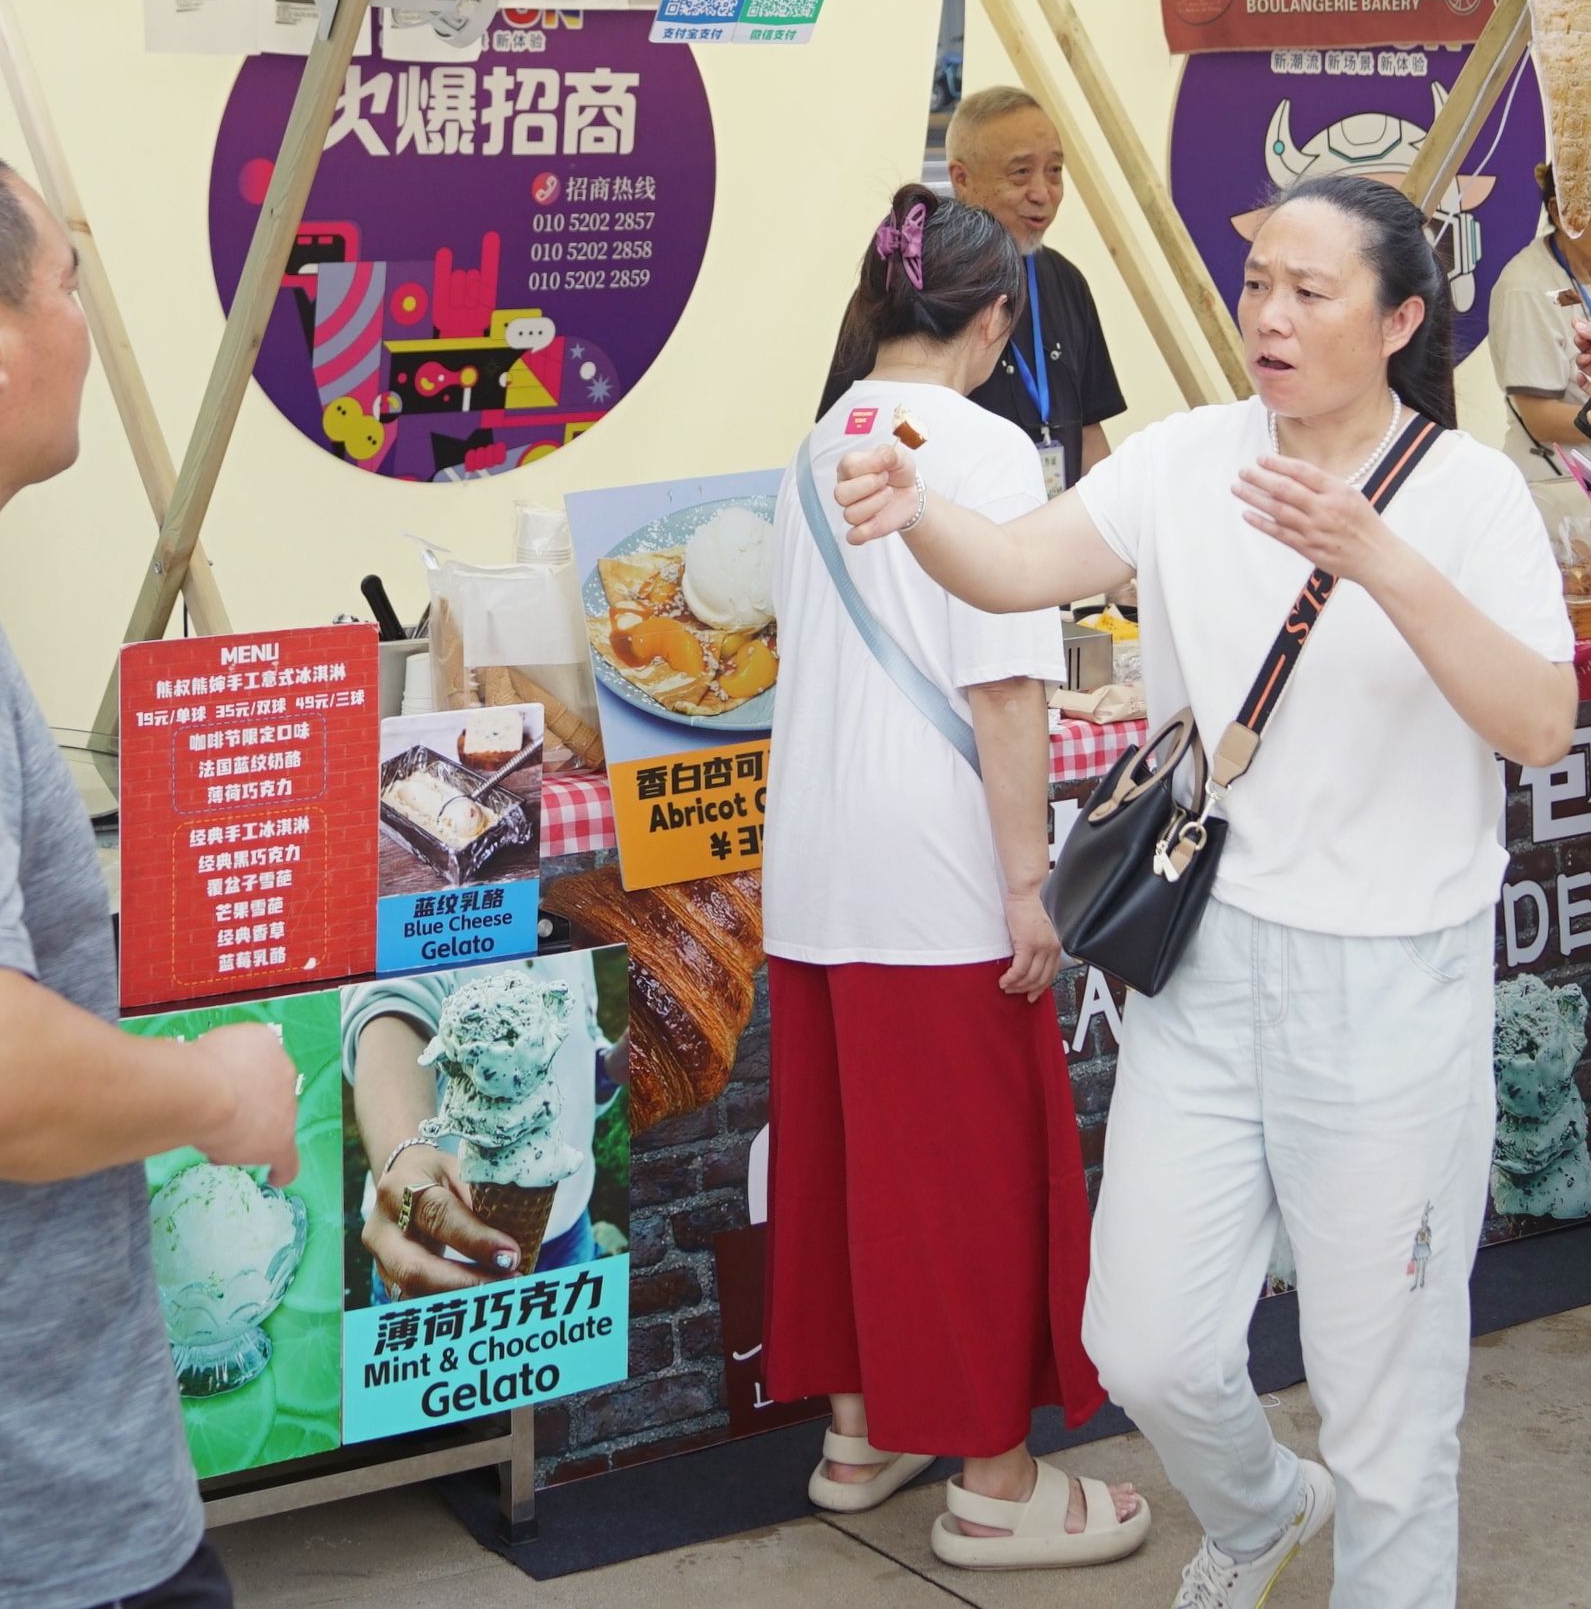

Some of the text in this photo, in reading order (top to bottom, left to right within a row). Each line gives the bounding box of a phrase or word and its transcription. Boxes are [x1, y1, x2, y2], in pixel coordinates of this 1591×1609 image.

[493, 30, 546, 51] 新体验
[661, 27, 725, 42] 支付宝支付
[749, 28, 799, 42] 微信支付
[1271, 52, 1428, 76] 新潮流 新场景 新体验
[322, 65, 641, 157] 火爆招商
[565, 176, 657, 203] 招商热线
[532, 211, 656, 233] 010 5202 2857
[530, 240, 653, 262] 010 5202 2858
[528, 268, 651, 291] 010 5202 2859
[220, 642, 280, 666] MENU
[156, 662, 347, 700] 熊叔熊婶手工意式冰淇淋
[136, 689, 366, 727] 19元/单球 35元/双球 49元/三球
[188, 721, 311, 753] 咖啡节限定口味
[197, 750, 302, 779] 法国蓝纹奶酪
[635, 749, 771, 801] 香白杏可
[206, 777, 293, 805] 薄荷巧克力
[648, 792, 748, 834] Abricot
[188, 814, 311, 848] 经典手工冰淇淋
[737, 824, 765, 857] 3
[197, 844, 301, 874] 经典黑巧克力
[205, 869, 294, 898] 覆盆子雪葩
[214, 896, 285, 923] 芒果雪葩
[412, 887, 505, 919] 蓝纹乳酪
[216, 920, 286, 948] 经典香草
[403, 911, 513, 938] Blue Cheese
[217, 946, 288, 973] 蓝莓乳酪
[420, 934, 495, 961] Gelato
[373, 1269, 604, 1357] 薄荷巧克力
[363, 1315, 614, 1389] Mint & Chocolate
[420, 1363, 560, 1418] Gelato
